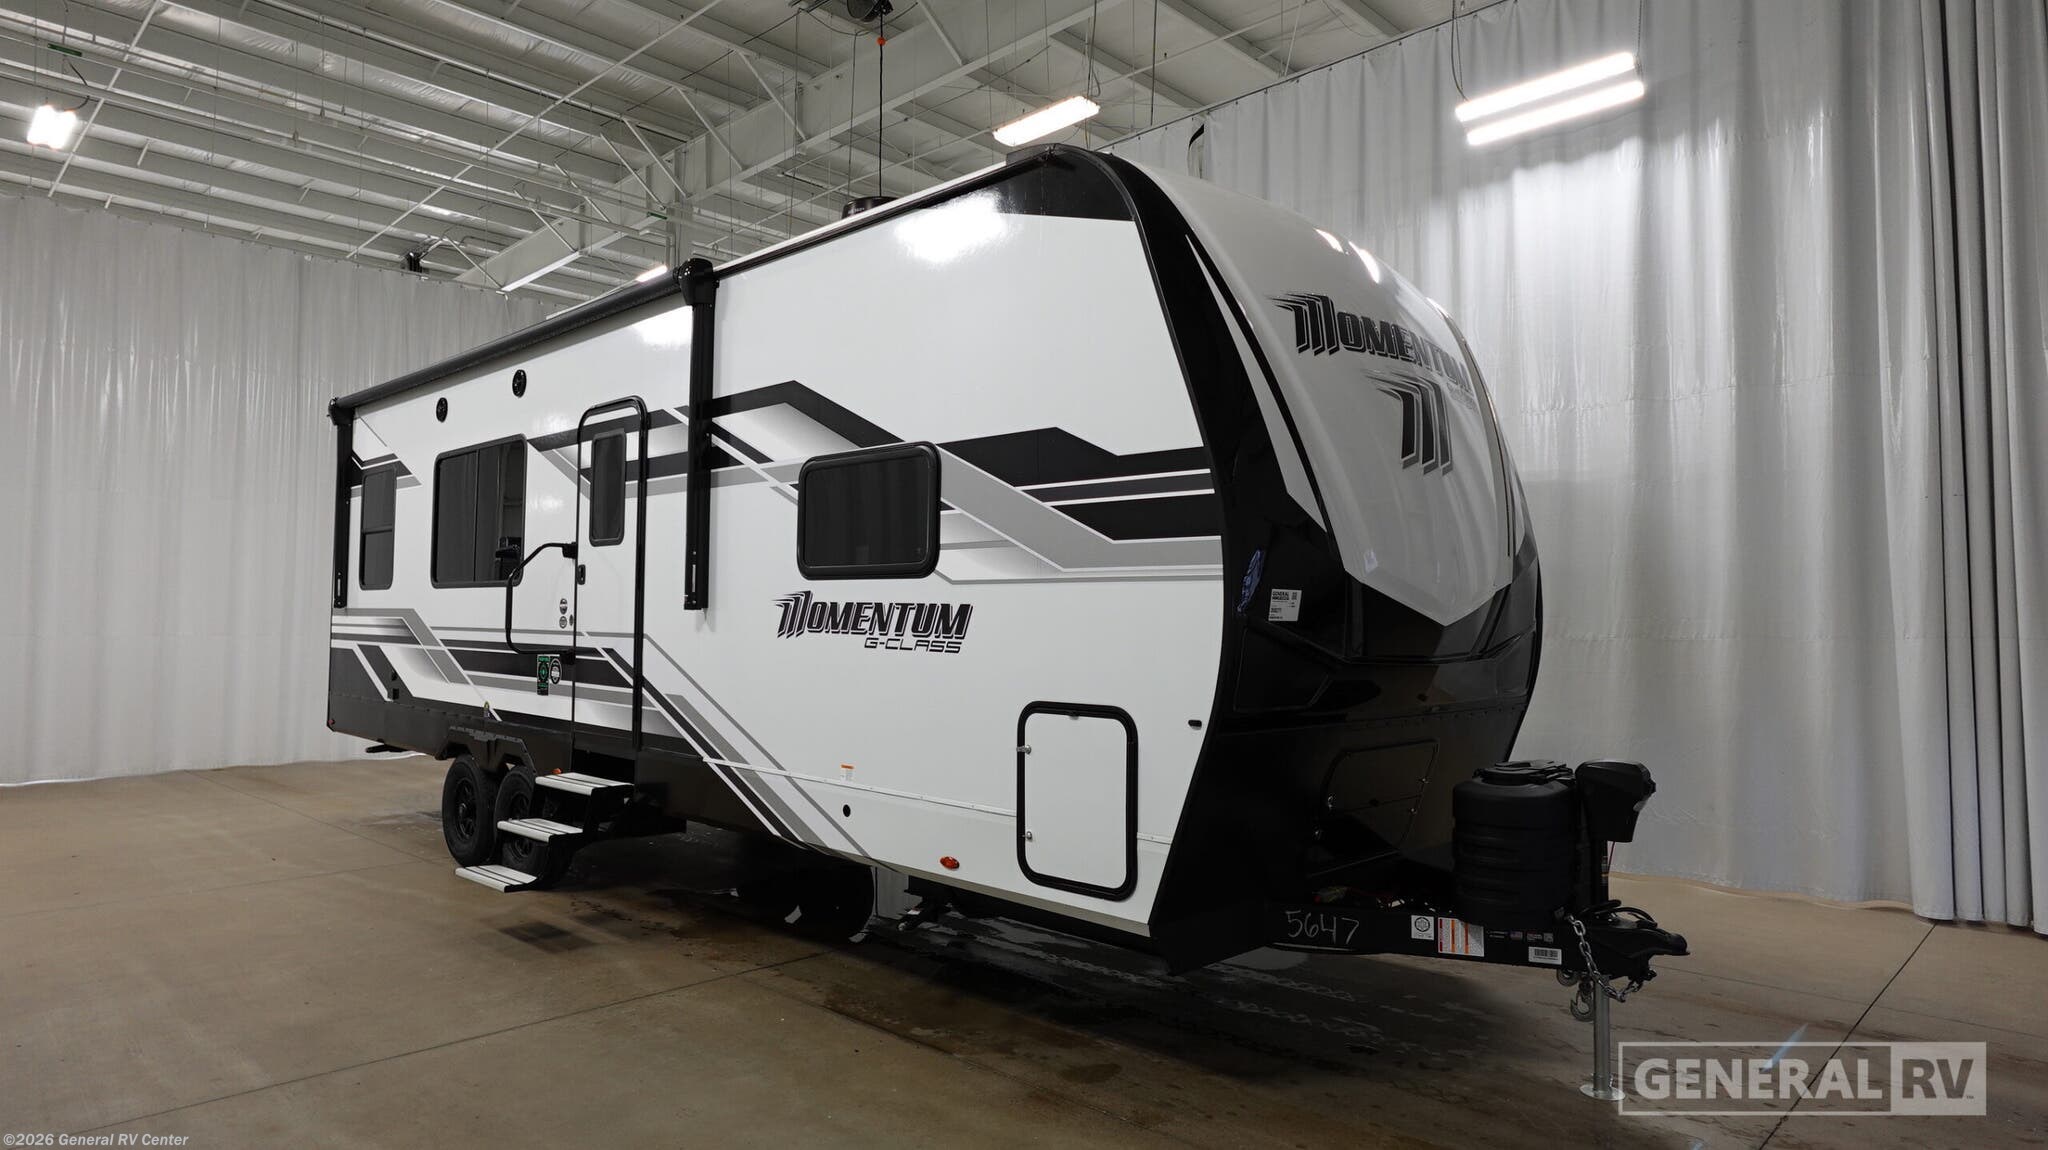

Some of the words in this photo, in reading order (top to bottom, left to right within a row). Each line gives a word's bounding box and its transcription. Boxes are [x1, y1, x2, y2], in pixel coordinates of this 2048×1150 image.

[1268, 291, 1473, 396] MOMENTUM
[772, 590, 973, 640] MOMENTUM
[864, 637, 962, 654] G-CLASS
[1285, 910, 1360, 945] 5647
